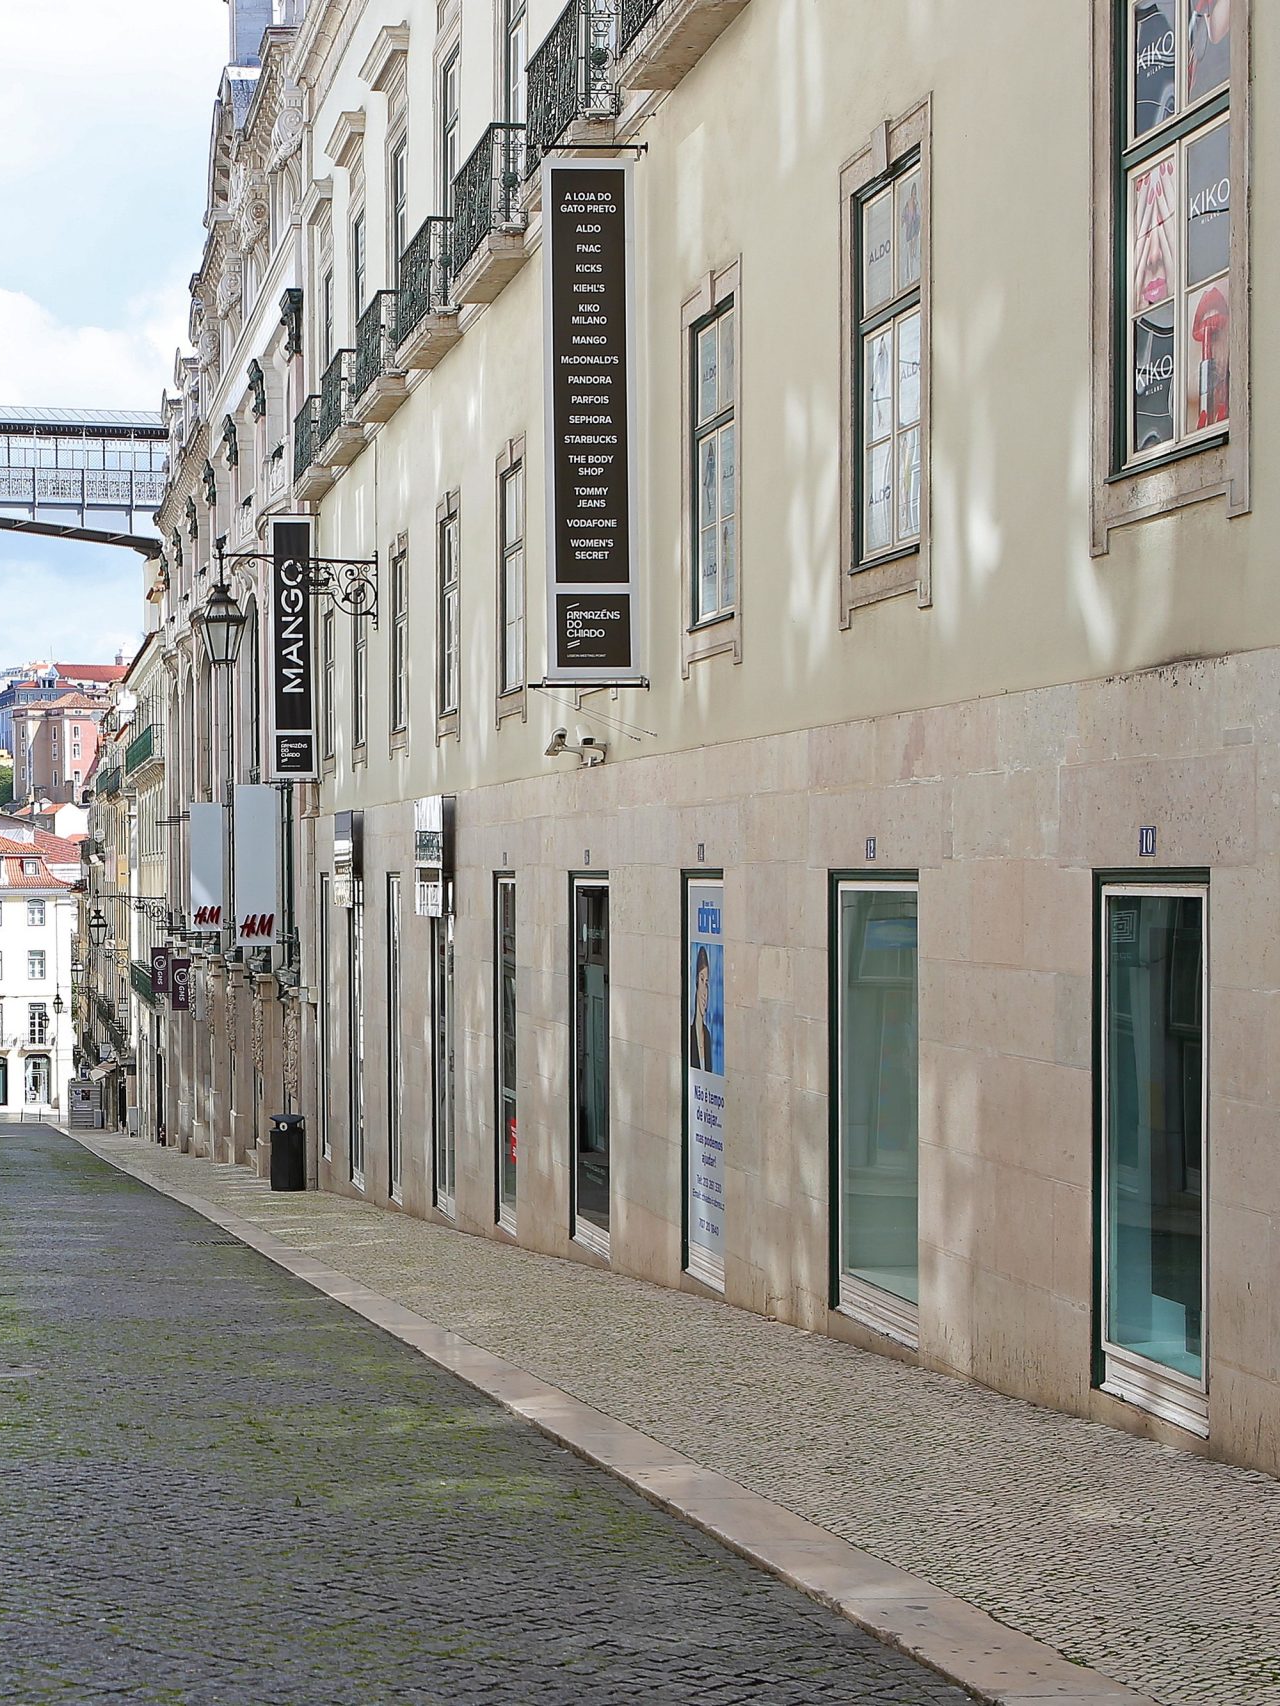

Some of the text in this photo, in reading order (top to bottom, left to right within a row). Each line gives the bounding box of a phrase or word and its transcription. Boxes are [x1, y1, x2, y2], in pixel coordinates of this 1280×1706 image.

[1136, 30, 1175, 75] KIKO
[1189, 177, 1230, 220] KIKO
[560, 205, 616, 213] GATO PRETO
[576, 225, 601, 233] ALDO
[576, 244, 601, 252] FNAC
[869, 239, 892, 267] ALDO
[576, 264, 602, 273] KICKS
[573, 284, 605, 292] KIEHL'S
[578, 304, 600, 312] KIKO
[572, 316, 607, 324] MILANO
[572, 336, 607, 344] MANGO
[560, 356, 619, 364] McDONALD'S
[900, 360, 920, 384] ALD
[1136, 354, 1173, 392] KIKO
[568, 376, 612, 384] PANDORA
[1145, 384, 1164, 396] MILANO
[572, 396, 609, 404] PARFOIS
[569, 416, 612, 424] SEPHORA
[564, 435, 618, 444] STARBUCKS
[568, 456, 614, 464] THE BODY
[578, 467, 604, 476] SHOP
[574, 487, 608, 496] TOMMY
[577, 499, 606, 508] JEANS
[566, 519, 617, 528] VODAFONE
[570, 538, 614, 548] WOMEN'S
[574, 551, 609, 560] SECRET
[566, 609, 620, 620] ARMAZÉNS
[280, 559, 304, 694] MANGO
[566, 620, 582, 628] DO
[566, 630, 605, 638] CHIADO
[1142, 829, 1153, 854] 10
[867, 839, 875, 859] 12
[194, 906, 222, 925] H&M
[240, 913, 274, 938] H&M
[178, 986, 186, 1002] GNS
[694, 1085, 724, 1110] Não é tempo
[696, 1106, 703, 1121] de
[696, 1133, 723, 1151] mas podemos
